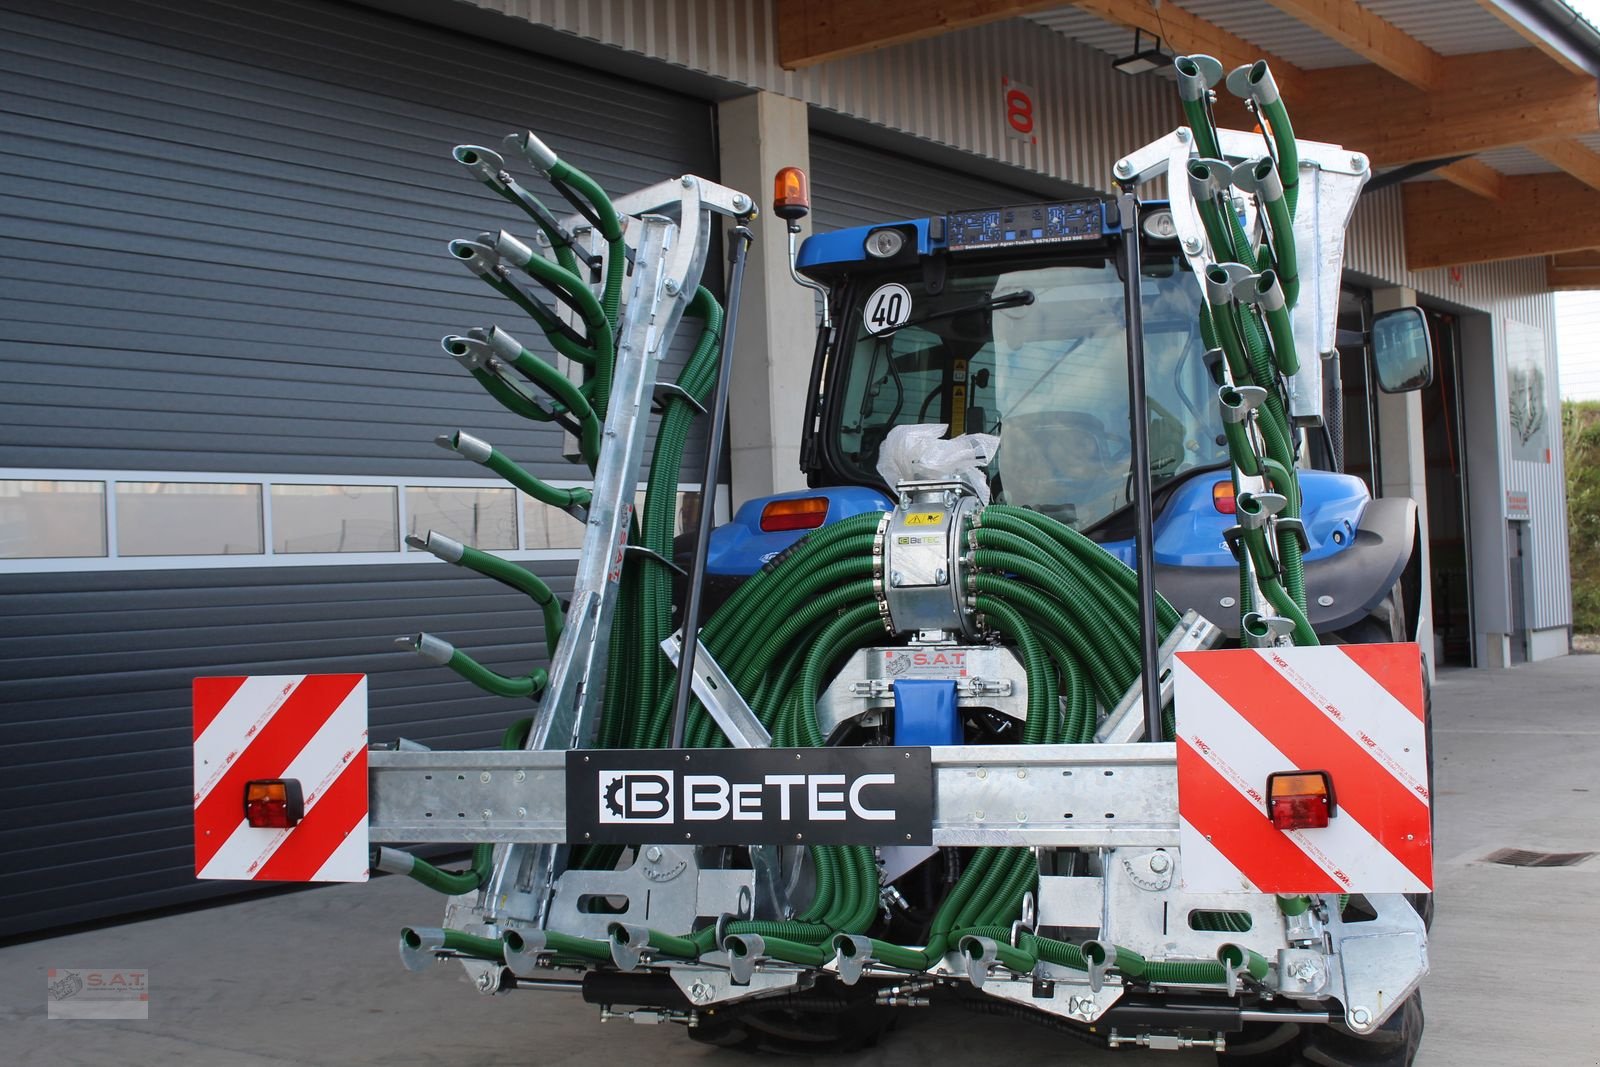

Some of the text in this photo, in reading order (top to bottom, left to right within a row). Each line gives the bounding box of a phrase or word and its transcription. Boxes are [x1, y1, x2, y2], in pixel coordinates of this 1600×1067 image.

[1007, 89, 1033, 134] 8
[871, 292, 903, 327] 40
[913, 652, 965, 666] S.A.T.
